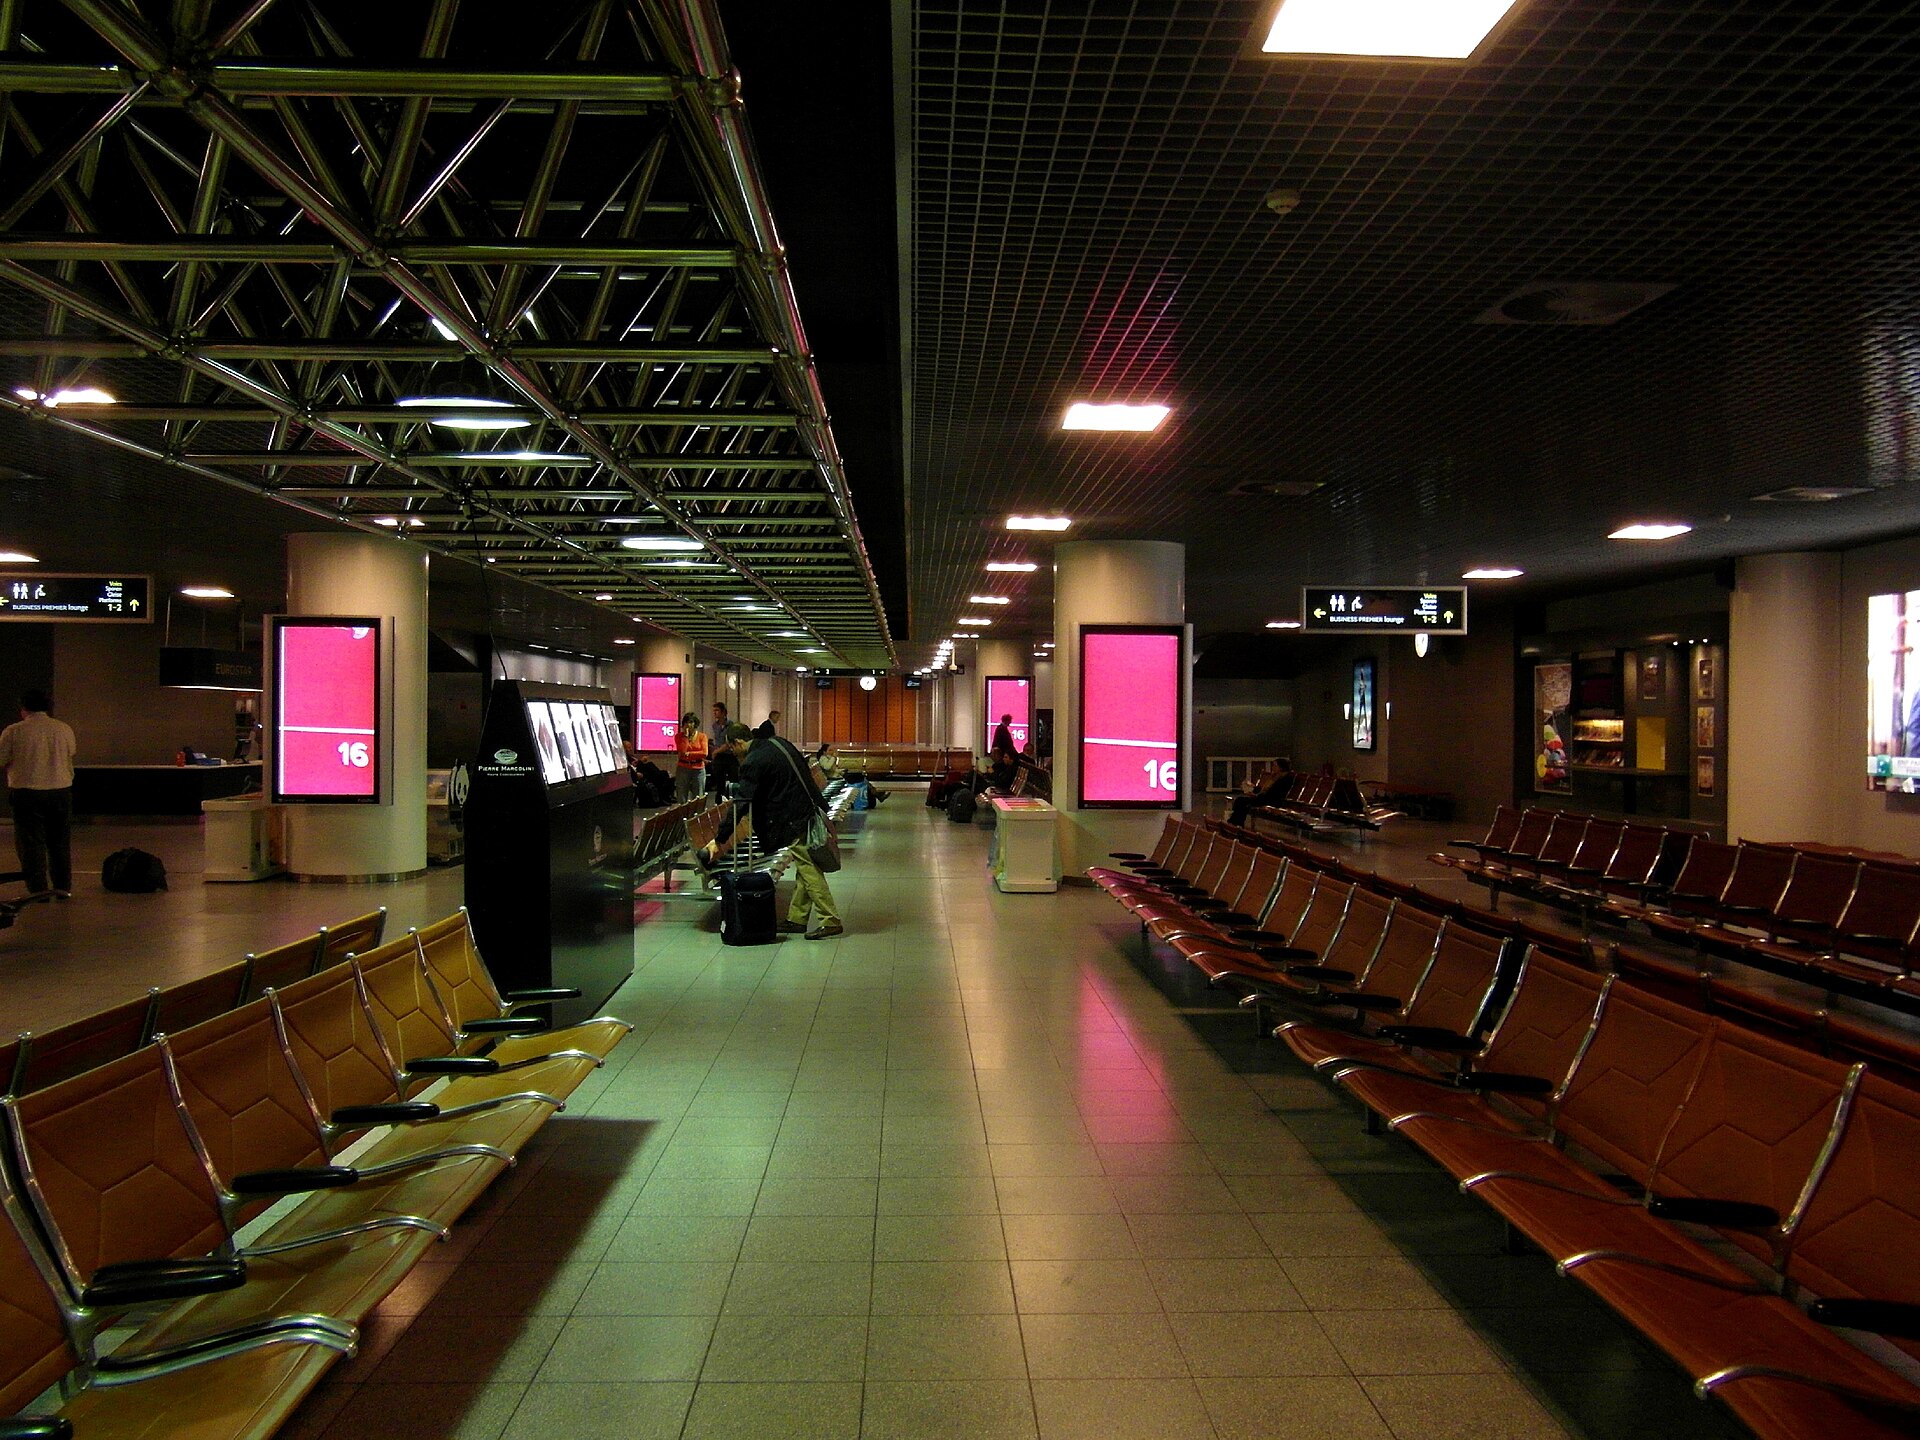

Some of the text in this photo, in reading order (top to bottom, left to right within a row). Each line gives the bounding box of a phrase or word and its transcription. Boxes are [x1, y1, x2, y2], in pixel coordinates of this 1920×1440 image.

[68, 604, 89, 612] lounge
[108, 604, 122, 612] 1-2
[1384, 616, 1405, 625] lounge
[1422, 615, 1437, 623] 1-2
[661, 725, 675, 737] 16
[1011, 729, 1025, 741] 16
[338, 741, 369, 768] 16
[1143, 759, 1177, 791] 16
